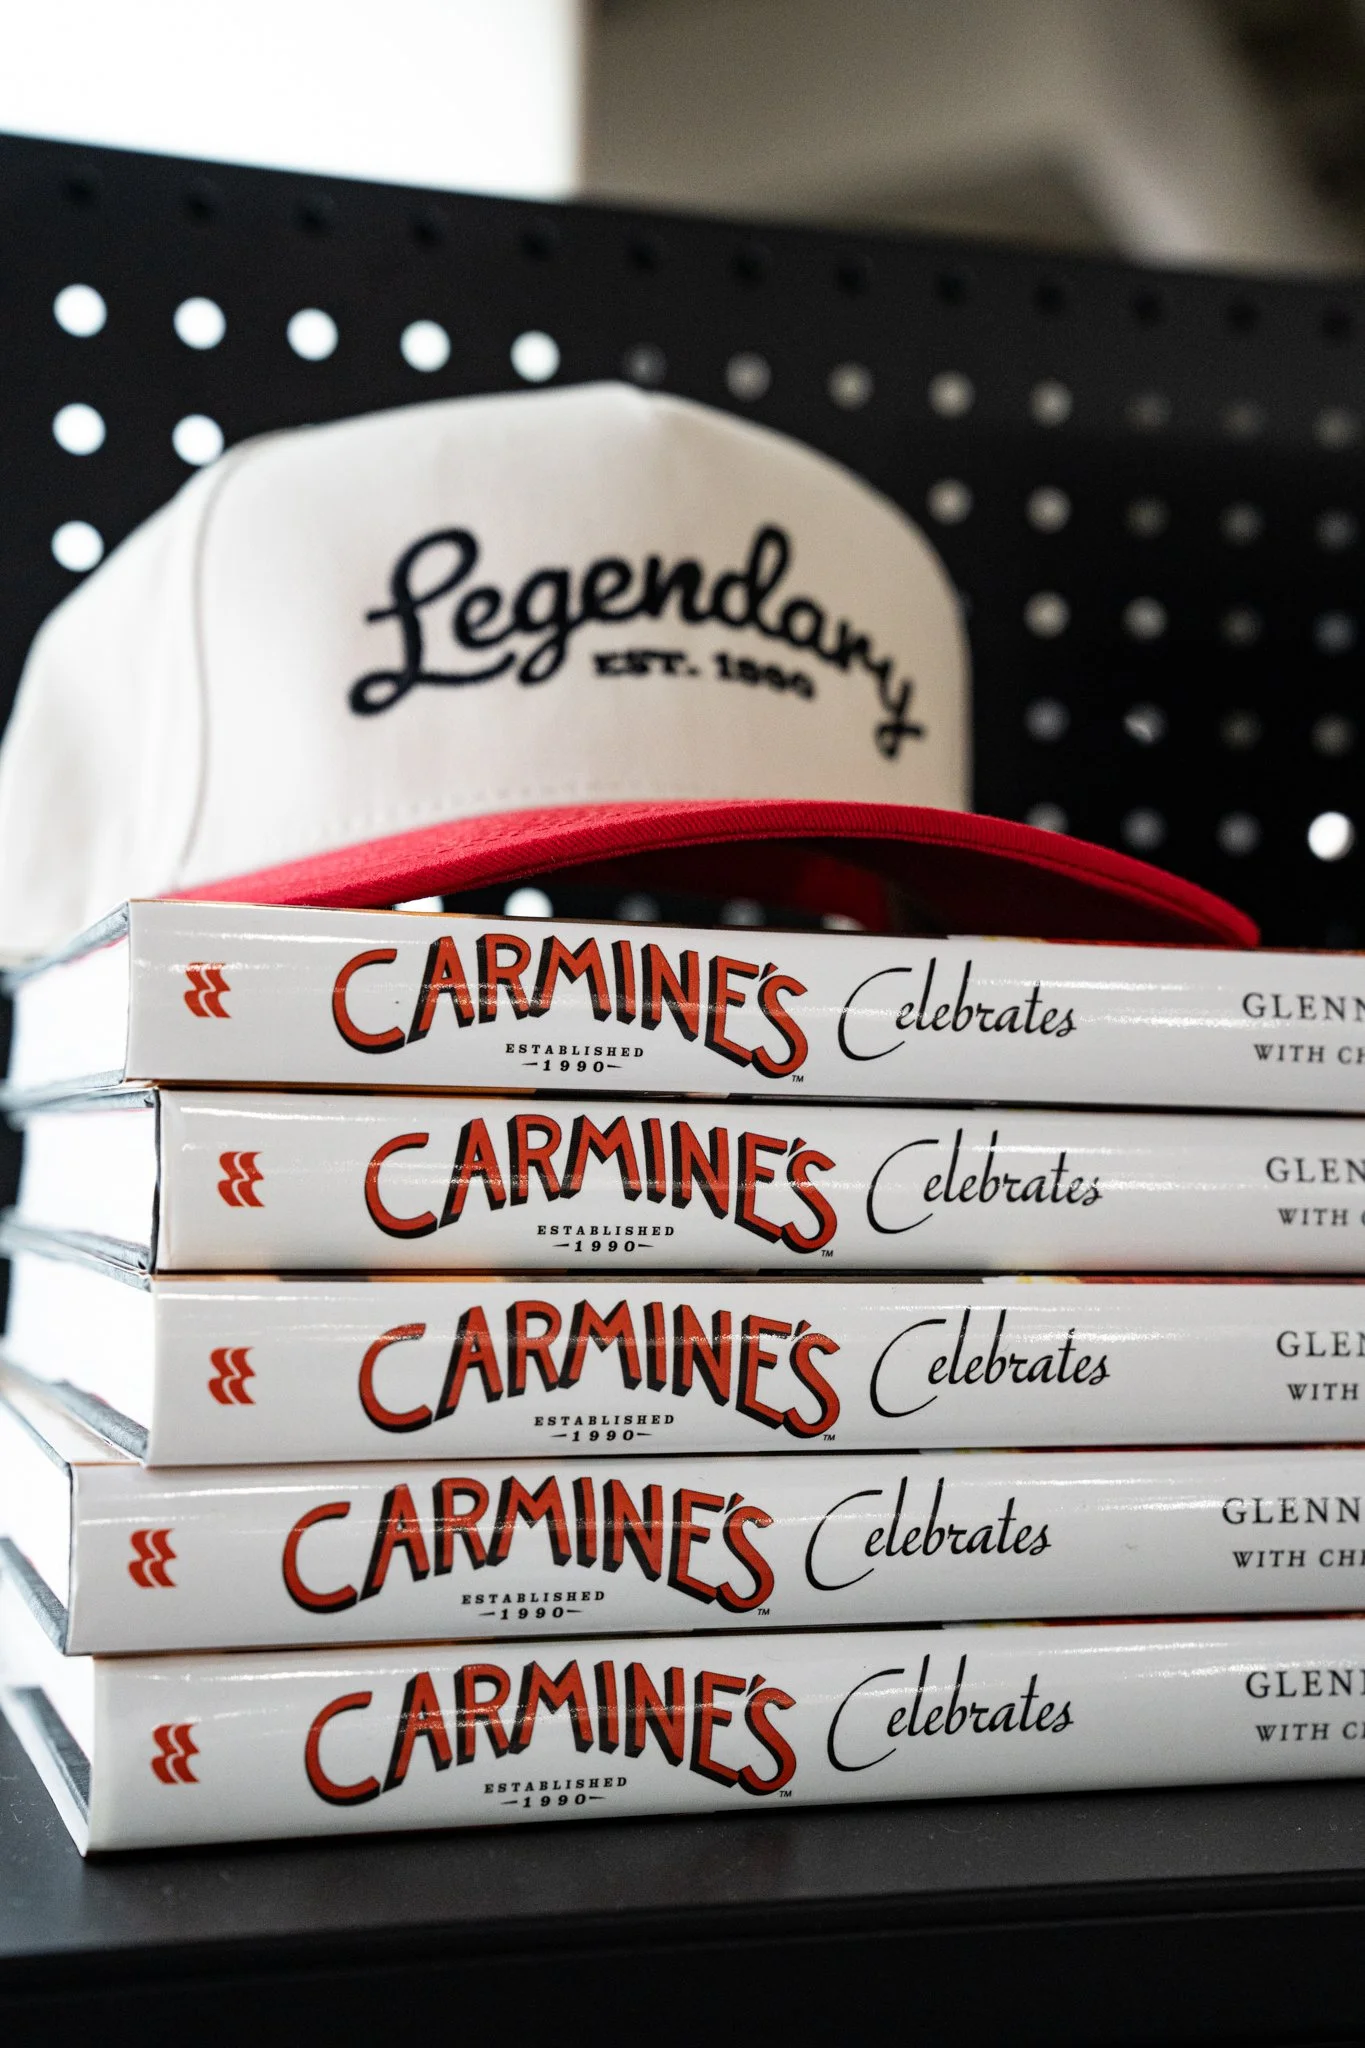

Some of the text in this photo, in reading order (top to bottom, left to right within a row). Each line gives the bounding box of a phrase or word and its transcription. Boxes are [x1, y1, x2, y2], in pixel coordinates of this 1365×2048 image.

[347, 523, 926, 760] Legendary
[593, 647, 699, 679] EST.
[332, 934, 1077, 1079] CARMINE'S Celebrates
[505, 1043, 645, 1058] ESTABLISHED
[1253, 1044, 1325, 1063] WITH
[542, 1059, 605, 1074] 1990
[364, 1114, 1103, 1254] CARMINE'S Celebrates
[1278, 1208, 1349, 1226] WITH
[537, 1225, 676, 1237] ESTABLISHED
[574, 1239, 636, 1254] 1990
[359, 1299, 1111, 1439] CARMINE'S Celebrates
[1287, 1383, 1360, 1401] WITH
[534, 1414, 676, 1427] ESTABLISHED
[571, 1429, 635, 1443] 1990
[1222, 1497, 1361, 1525] GLENN
[283, 1475, 1052, 1614] CARMINE'S Celebrates
[1232, 1550, 1307, 1568] WITH
[462, 1591, 606, 1606] ESTABLISHED
[500, 1606, 565, 1621] 1990
[1246, 1669, 1365, 1698] GLEN
[305, 1654, 1074, 1806] CARMINE'S Celebrates
[1256, 1723, 1331, 1742] WITH
[484, 1776, 628, 1794] ESTABLISHED
[522, 1794, 588, 1809] 1990
